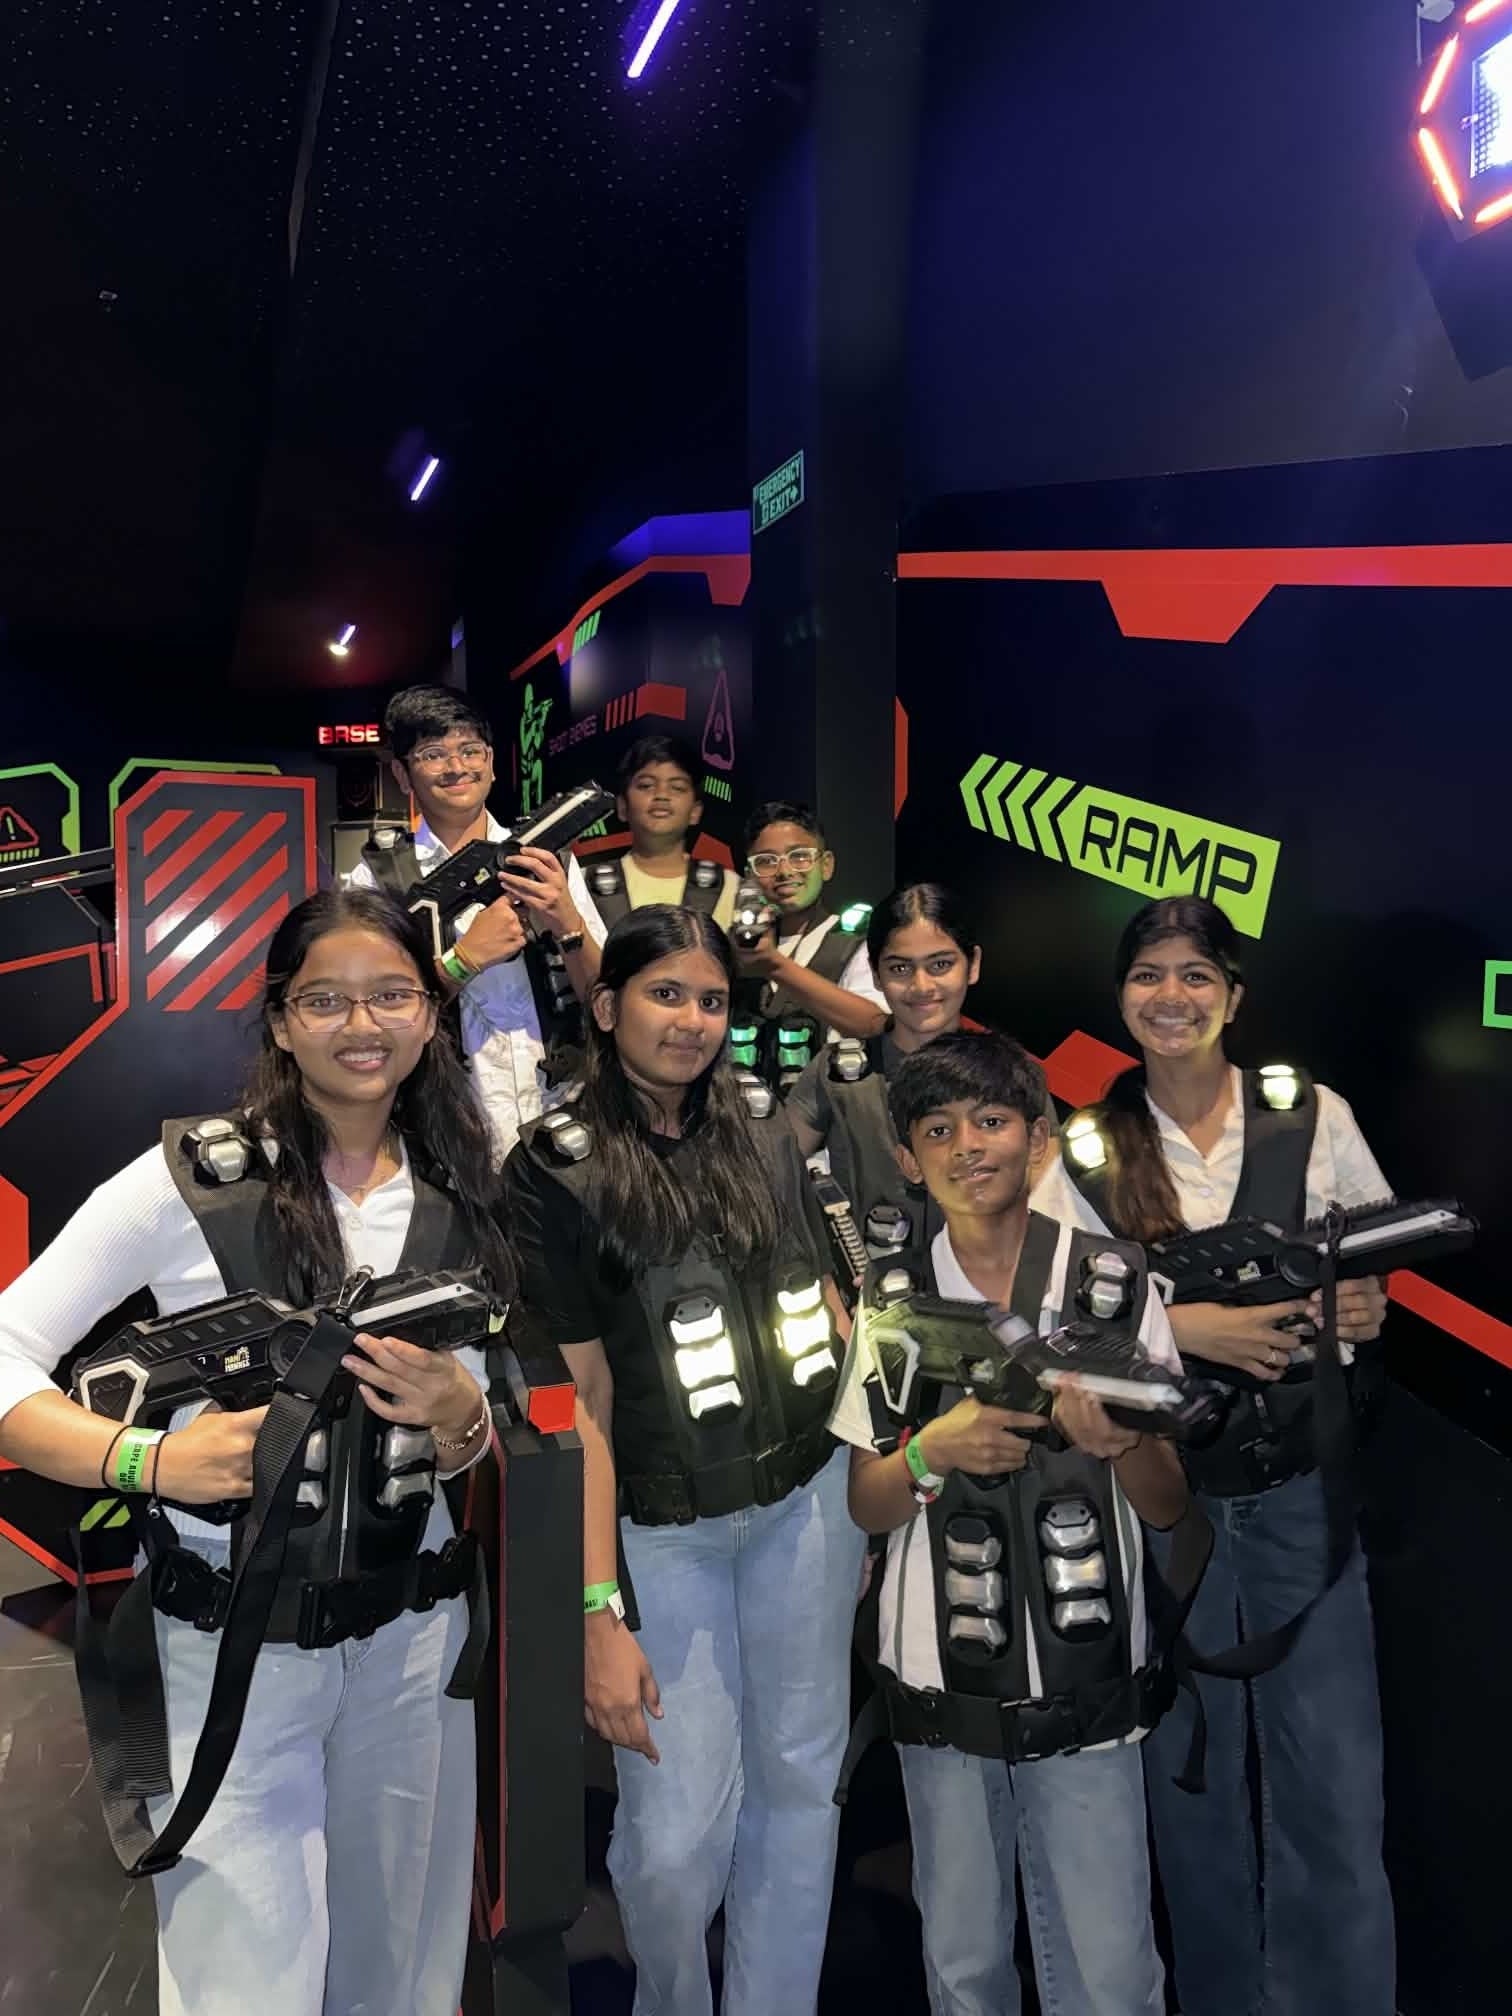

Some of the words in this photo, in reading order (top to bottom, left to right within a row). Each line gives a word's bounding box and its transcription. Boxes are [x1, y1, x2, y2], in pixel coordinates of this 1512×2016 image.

[770, 487, 791, 519] EXIT
[318, 724, 380, 744] BASE
[1079, 804, 1258, 902] RAMP
